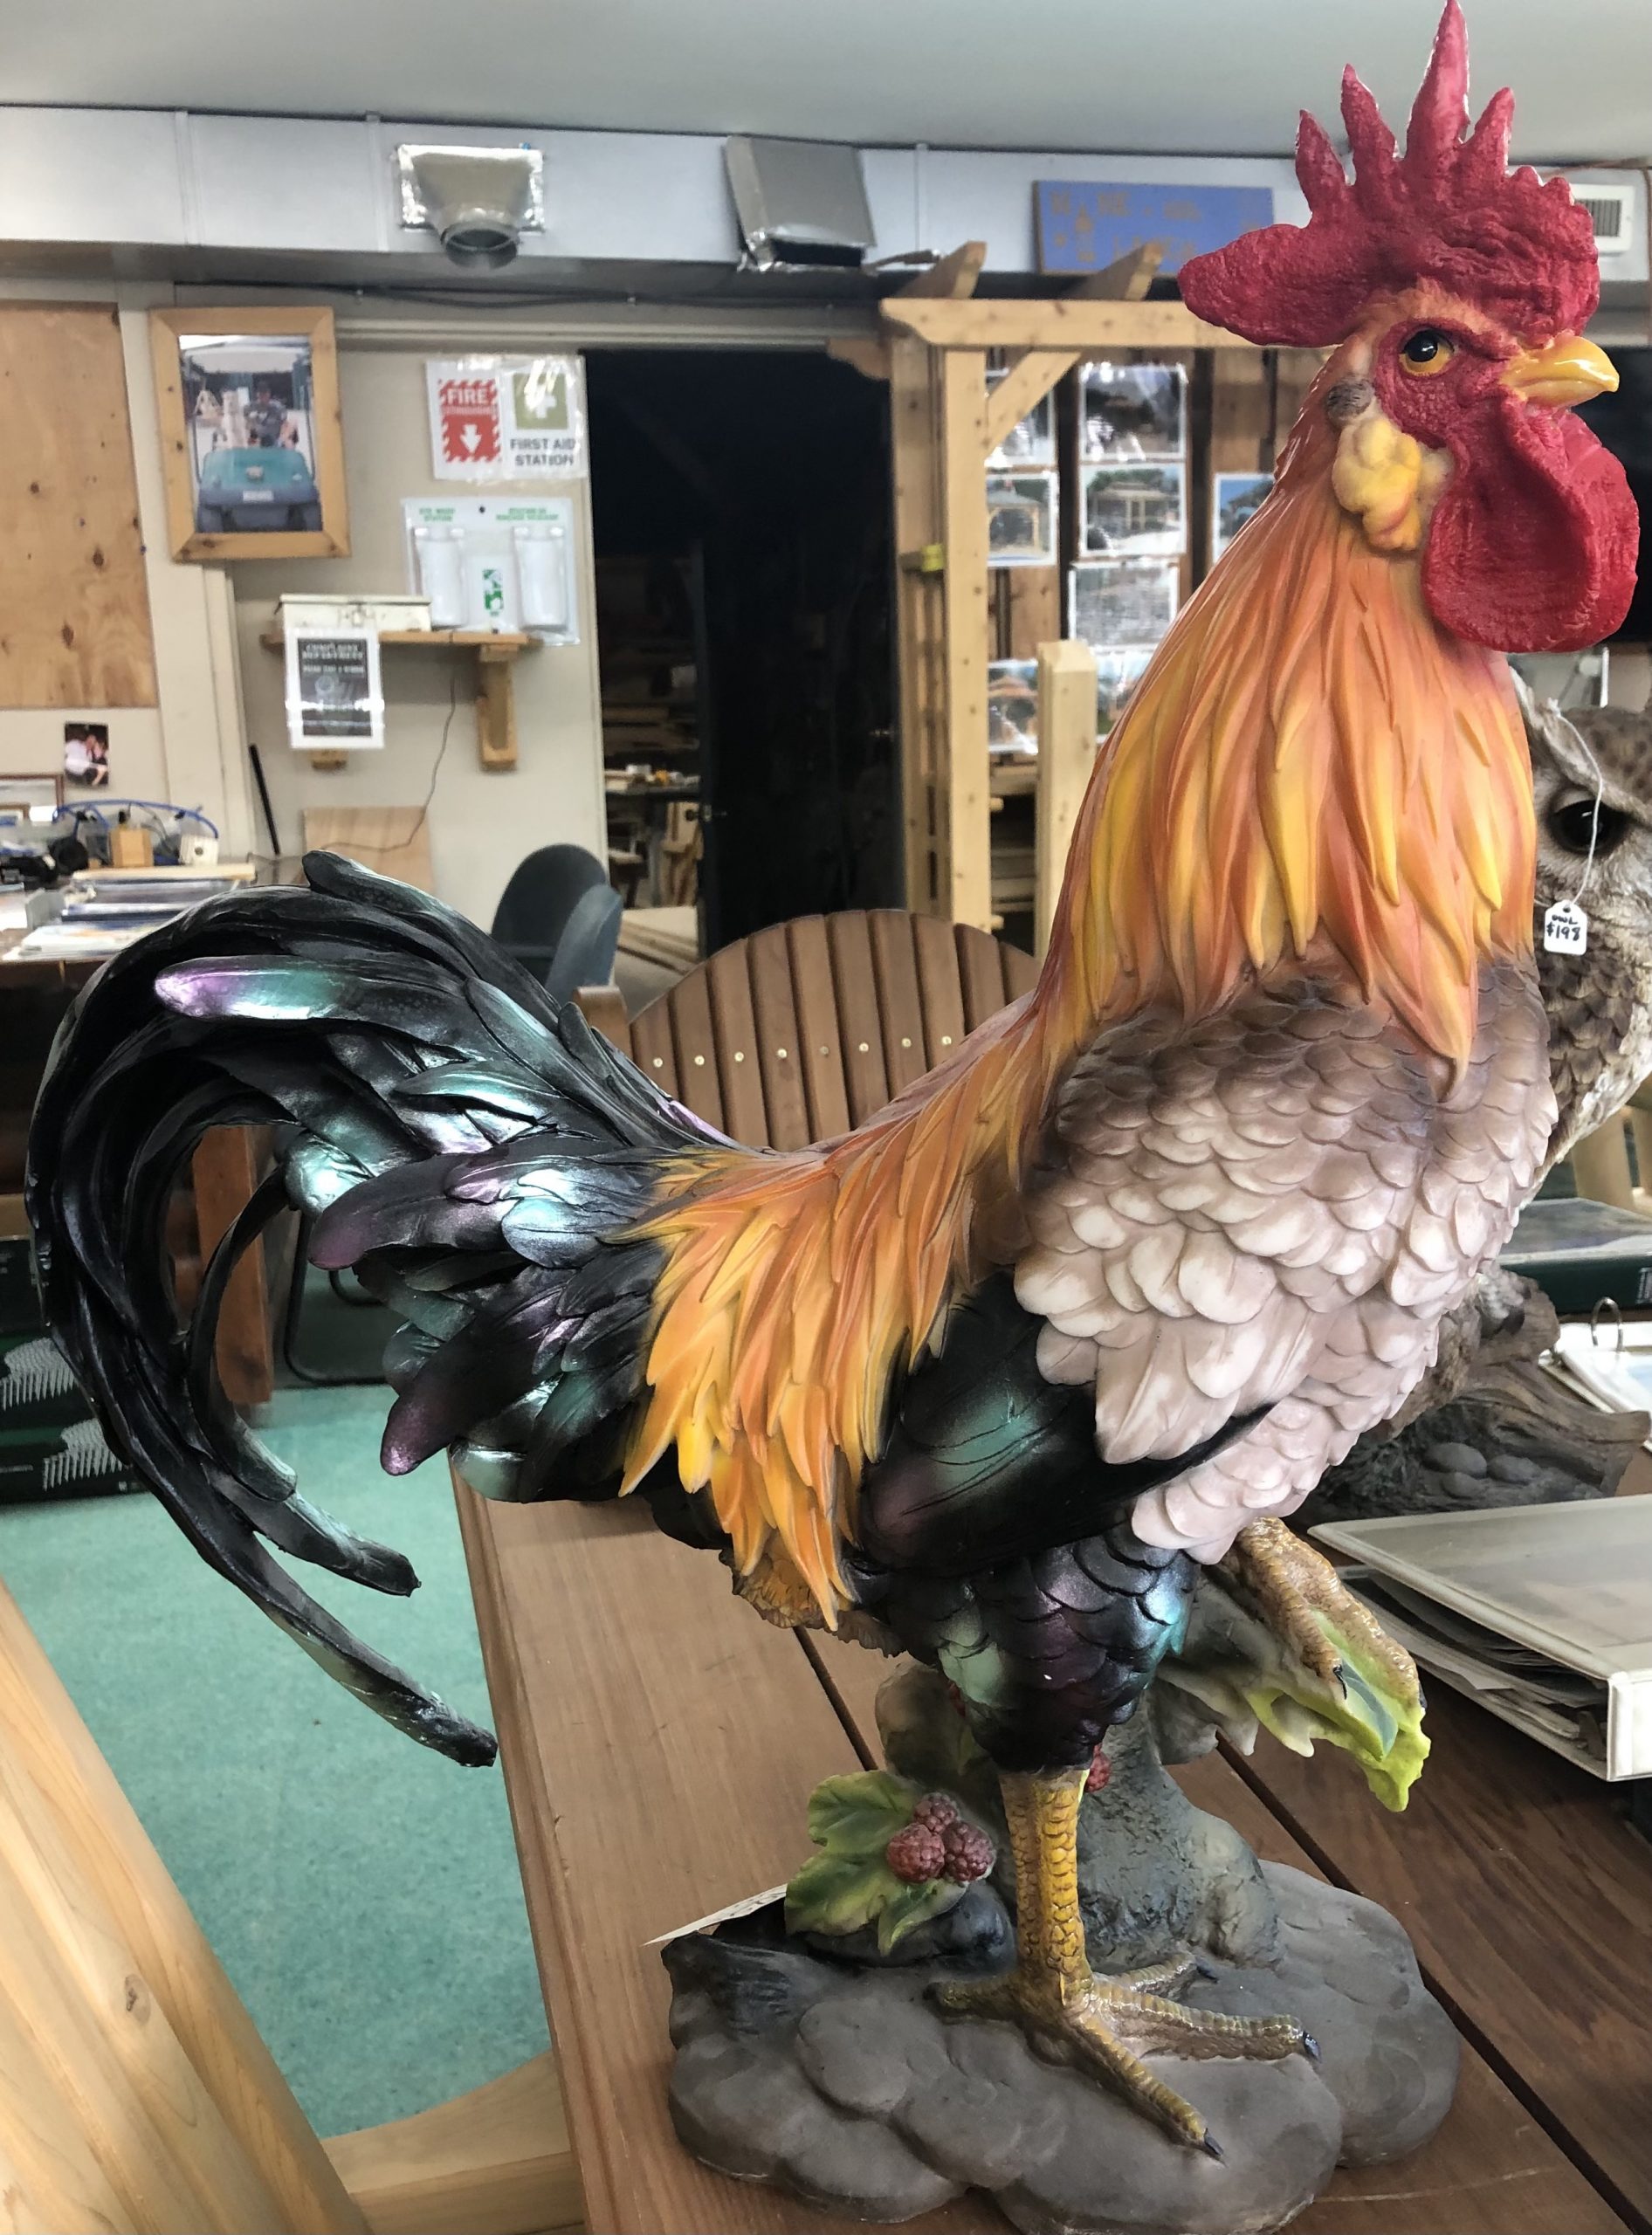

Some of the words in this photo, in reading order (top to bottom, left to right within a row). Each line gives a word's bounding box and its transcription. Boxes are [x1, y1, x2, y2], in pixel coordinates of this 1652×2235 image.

[447, 388, 489, 405] FIRE
[510, 438, 548, 450] FIRST
[553, 438, 576, 450] AID
[515, 454, 575, 466] STATION
